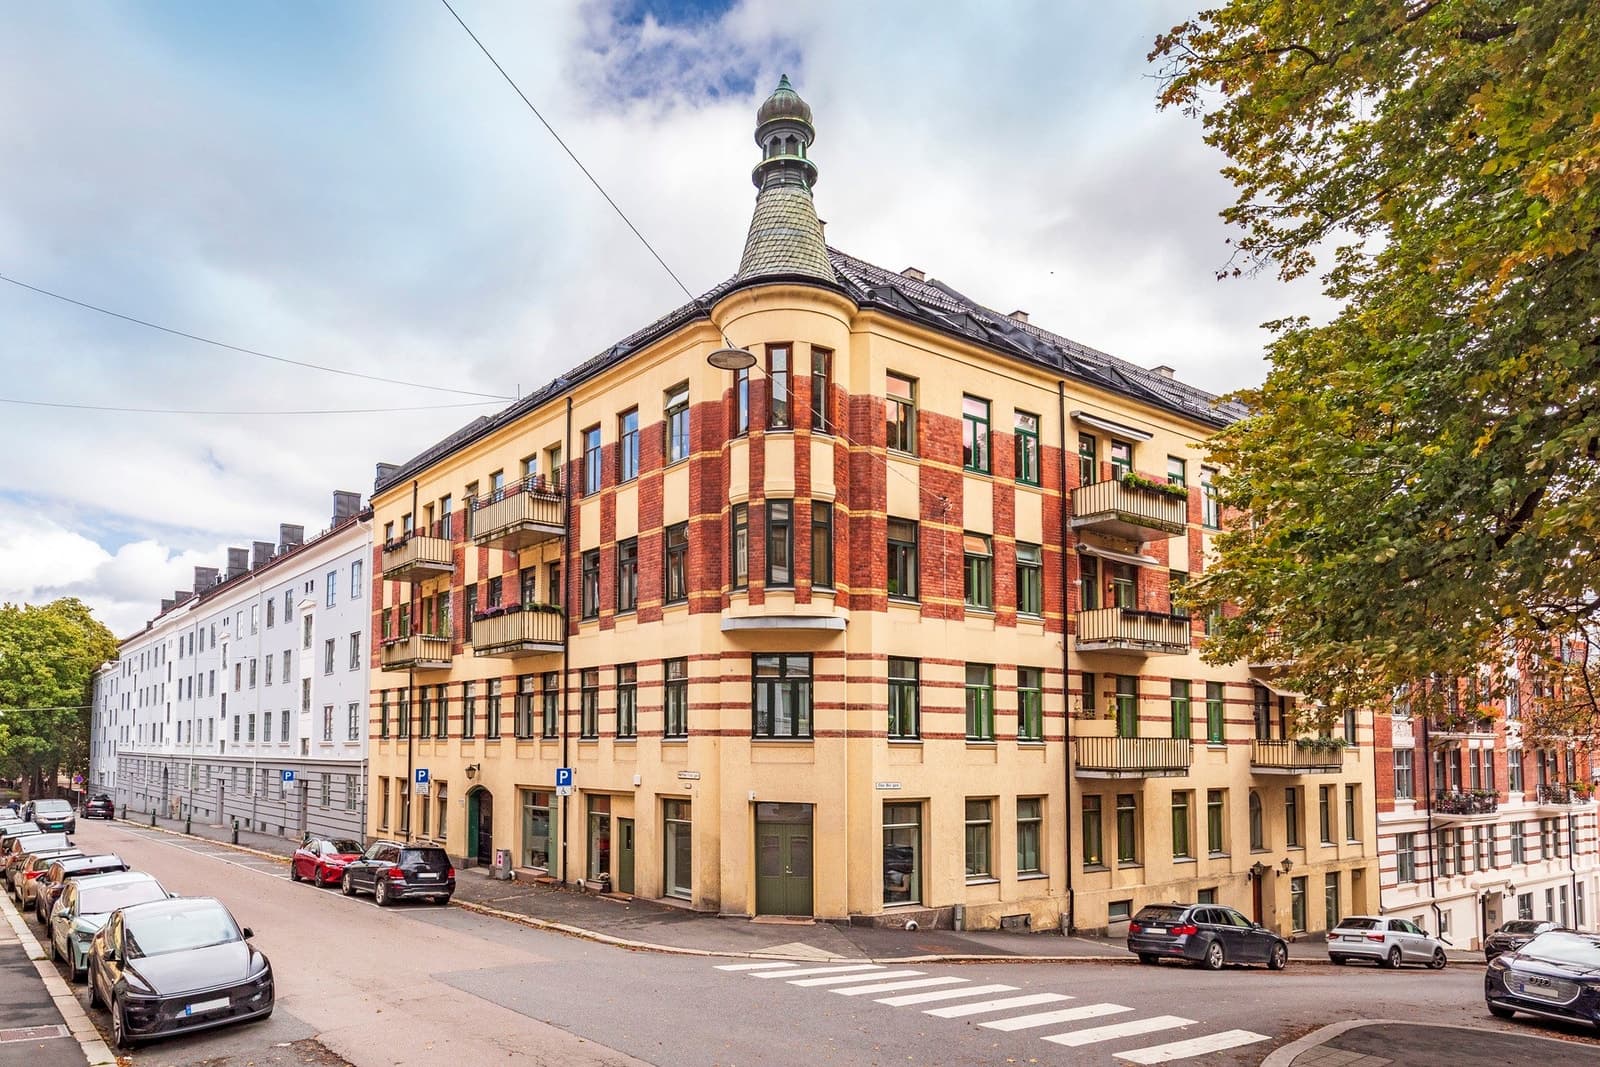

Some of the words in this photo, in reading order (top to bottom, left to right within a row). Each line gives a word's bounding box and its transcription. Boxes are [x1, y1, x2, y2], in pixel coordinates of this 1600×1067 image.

[285, 771, 292, 780] P
[418, 770, 426, 781] P
[560, 770, 568, 784] P
